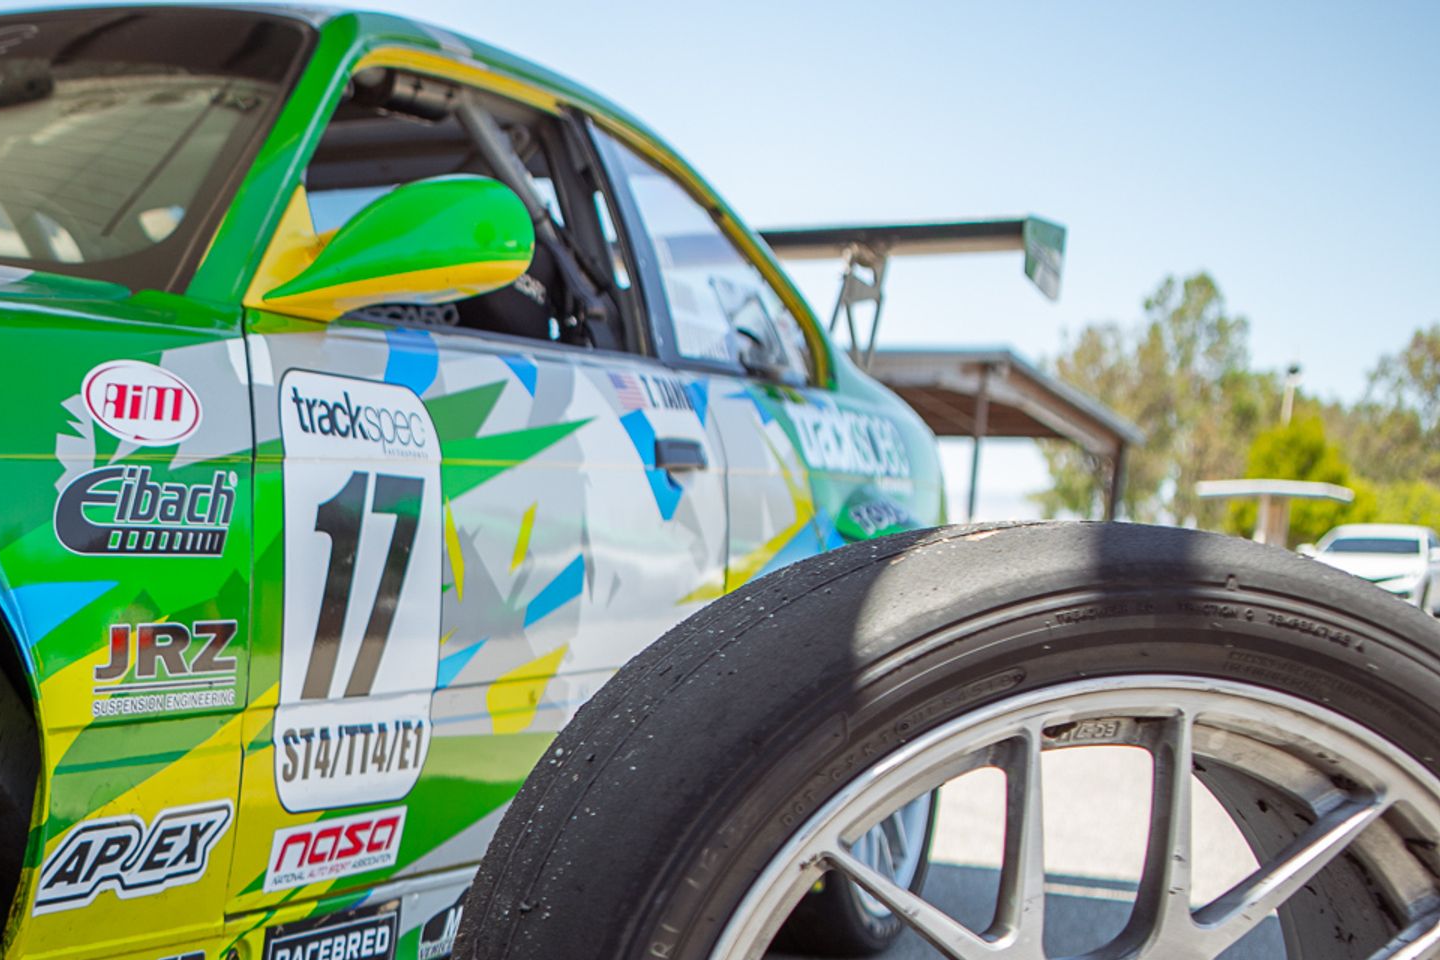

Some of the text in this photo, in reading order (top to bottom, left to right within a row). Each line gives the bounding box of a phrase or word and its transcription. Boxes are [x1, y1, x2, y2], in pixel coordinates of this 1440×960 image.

[292, 387, 427, 453] trackspec
[55, 466, 235, 556] Eibach
[301, 471, 425, 700] 17
[93, 620, 238, 681] JRZ
[93, 689, 236, 717] SUSPENSION ENGINEERING
[282, 721, 426, 784] ST4/TT4/E1
[274, 815, 400, 873] nasa
